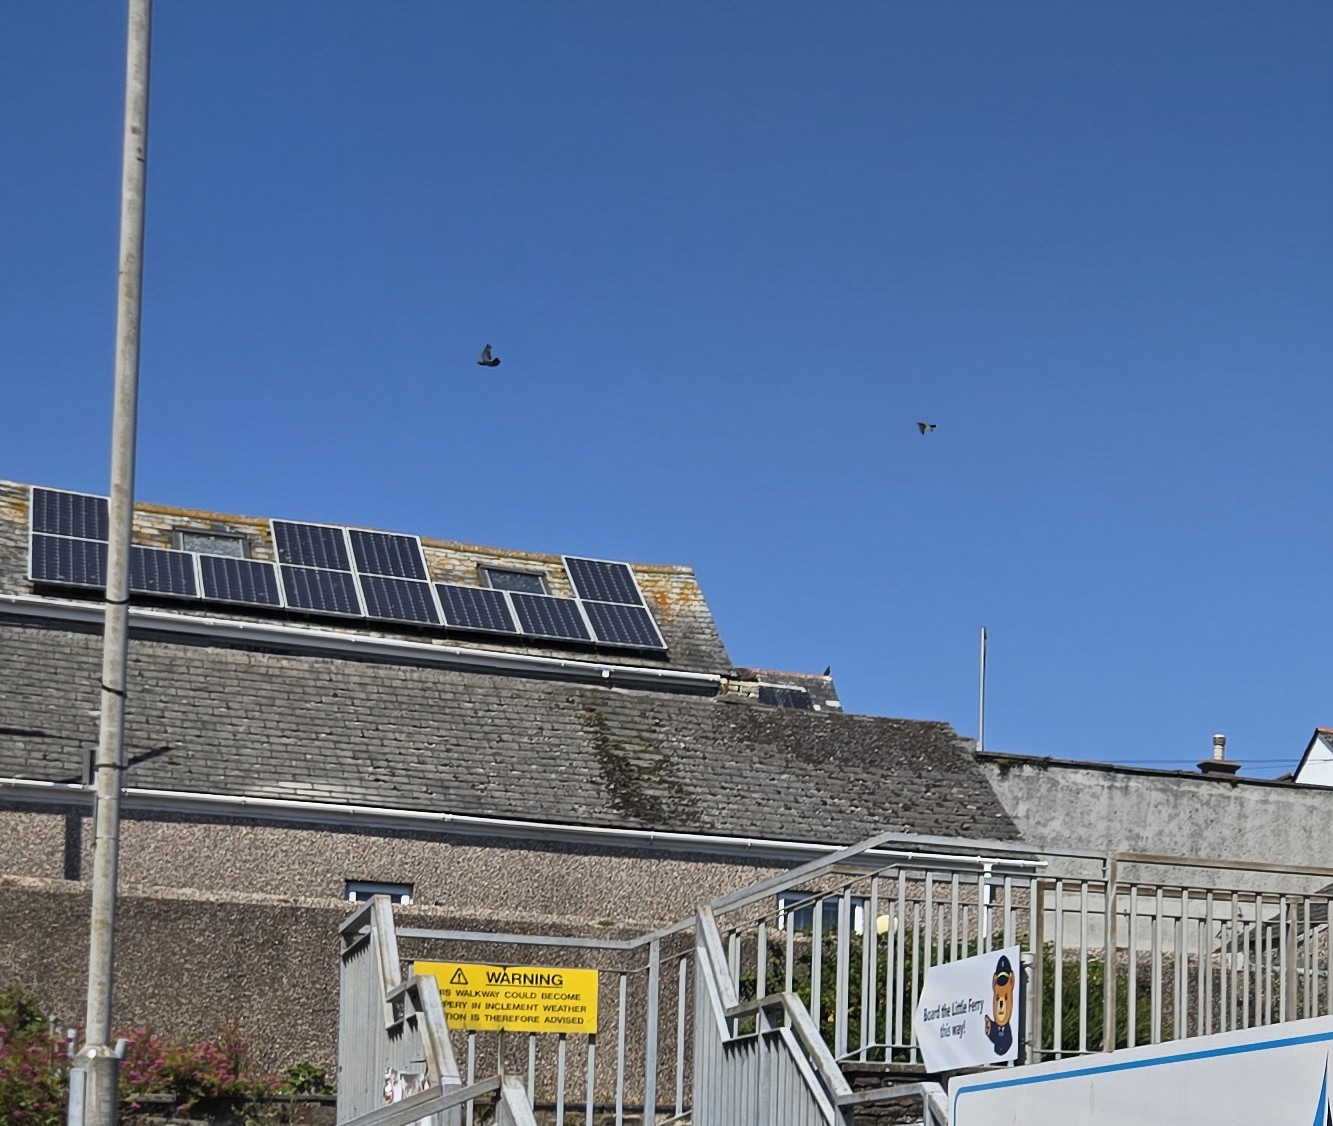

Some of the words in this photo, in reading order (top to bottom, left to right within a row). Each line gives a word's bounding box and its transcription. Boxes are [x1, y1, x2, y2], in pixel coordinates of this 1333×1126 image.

[486, 971, 564, 986] WARNING
[456, 990, 500, 998] WALKWAY
[505, 991, 537, 999] COULD
[541, 993, 581, 1001] BECOME
[485, 1003, 540, 1012] INCLEMENT
[543, 1005, 587, 1013] WEATHER
[923, 1004, 940, 1022] Board
[941, 1003, 951, 1018] the
[951, 999, 967, 1016] Little
[968, 998, 985, 1015] Ferry
[445, 1013, 467, 1022] TION
[471, 1014, 480, 1022] IS
[484, 1014, 540, 1023] THEREFORE
[544, 1016, 585, 1025] ADVISED
[940, 1022, 951, 1038] this
[951, 1019, 966, 1039] way!
